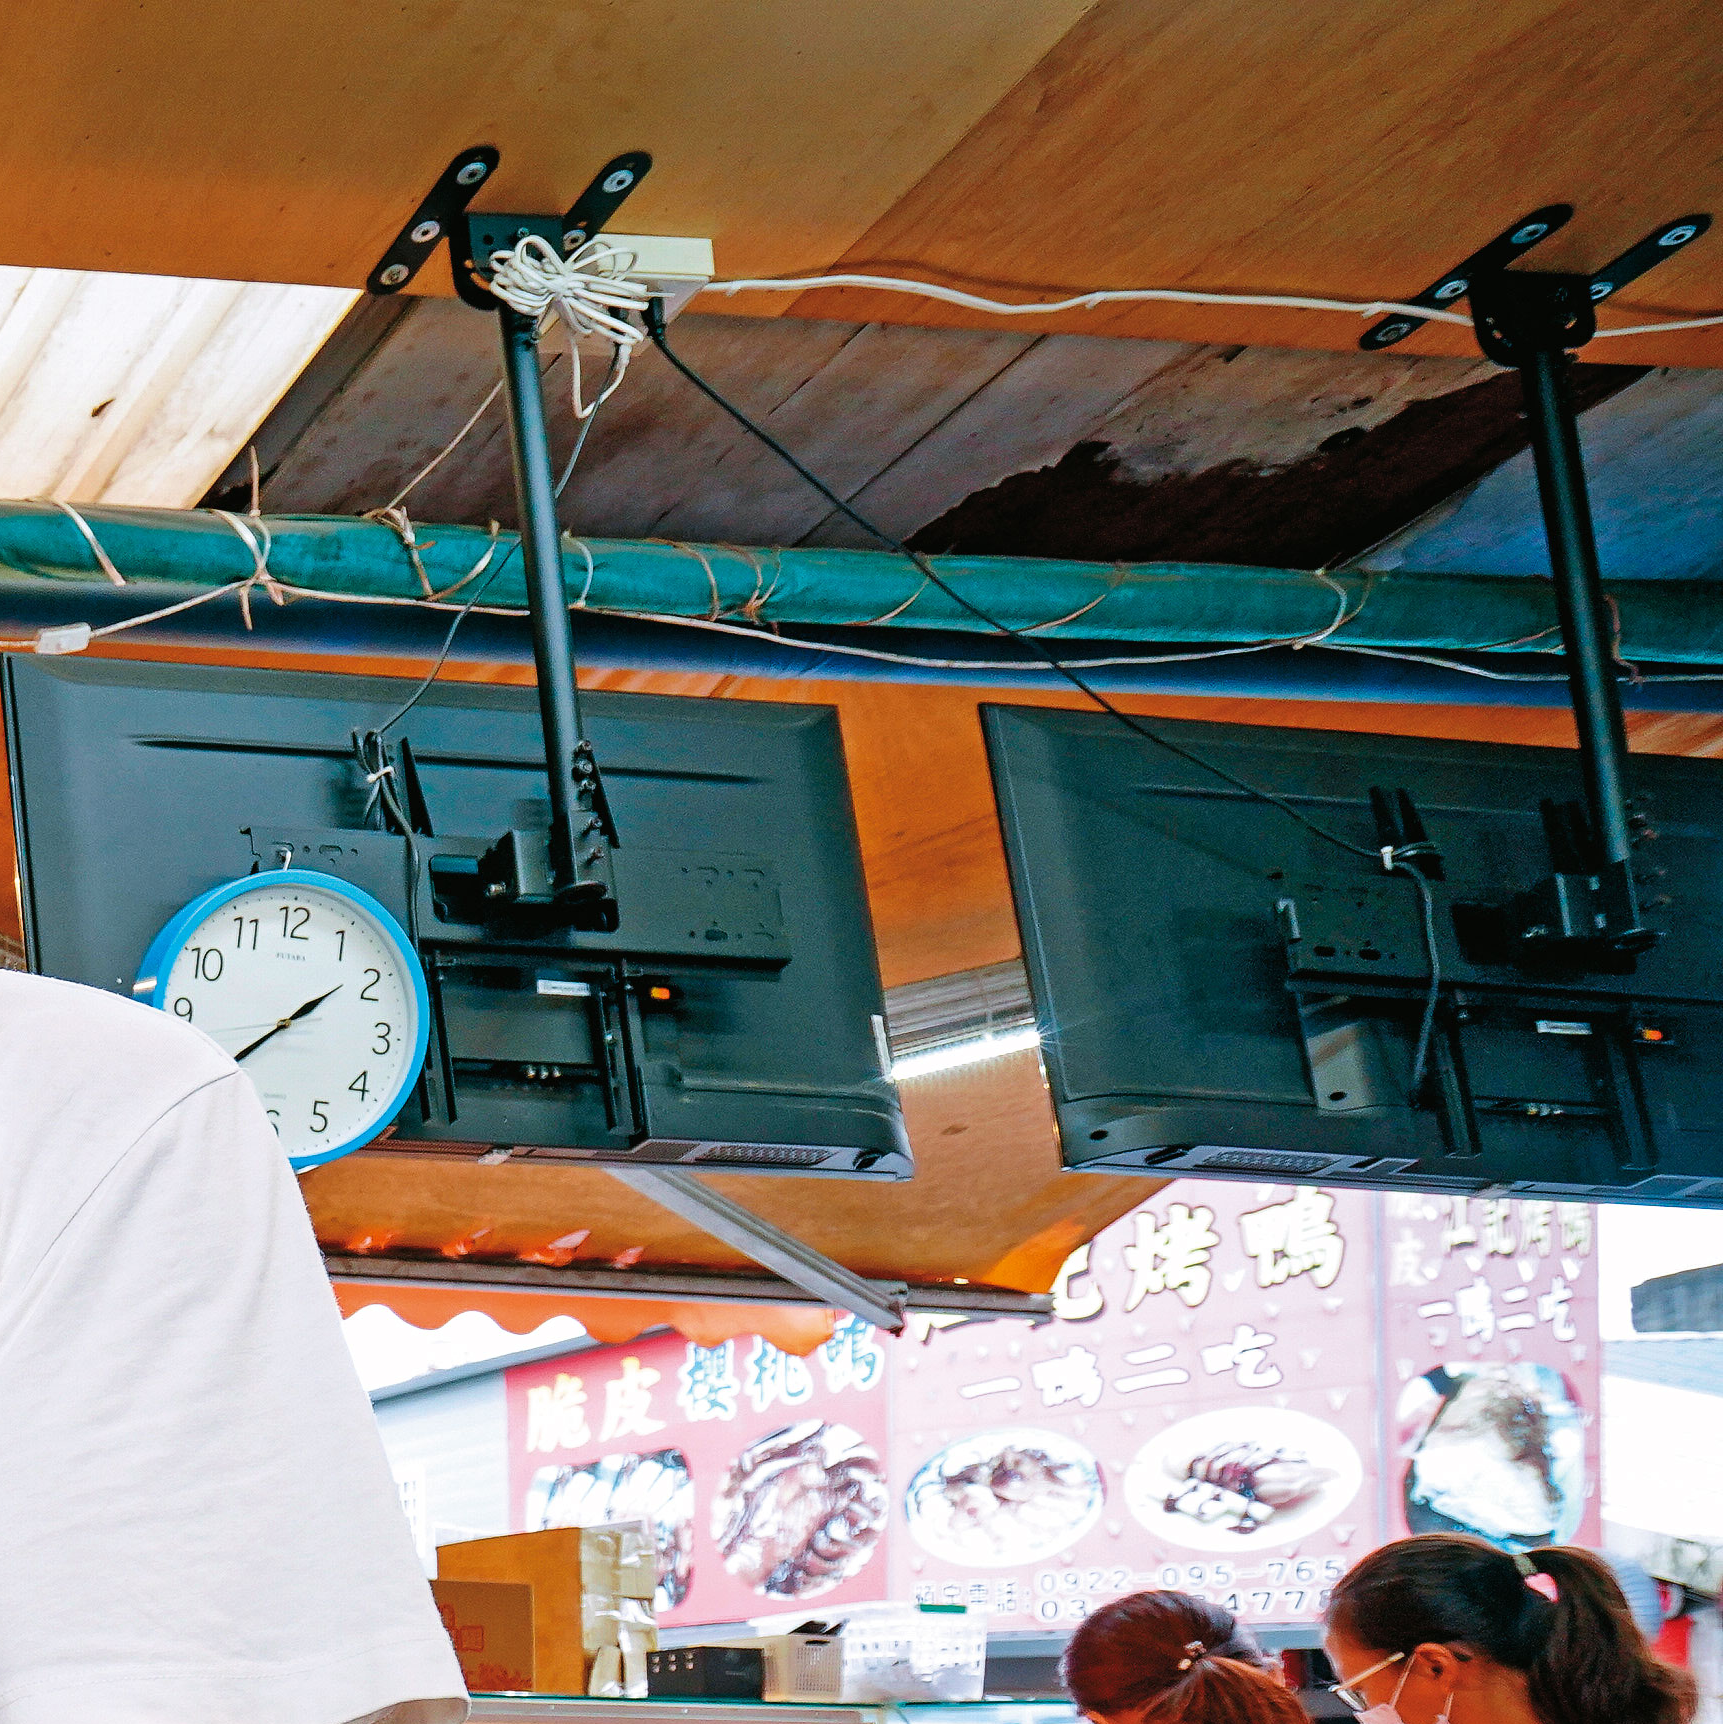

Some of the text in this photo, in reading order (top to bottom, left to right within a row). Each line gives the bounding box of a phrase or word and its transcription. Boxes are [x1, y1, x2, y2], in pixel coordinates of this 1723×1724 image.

[233, 916, 260, 950] 11
[279, 905, 311, 940] 12
[335, 930, 346, 961] 1
[191, 947, 224, 981] 10
[360, 968, 381, 1002] 2
[371, 1022, 391, 1055] 3
[347, 1070, 370, 1102] 4
[309, 1100, 330, 1133] 5
[958, 1324, 1283, 1408] 一鴨二吃
